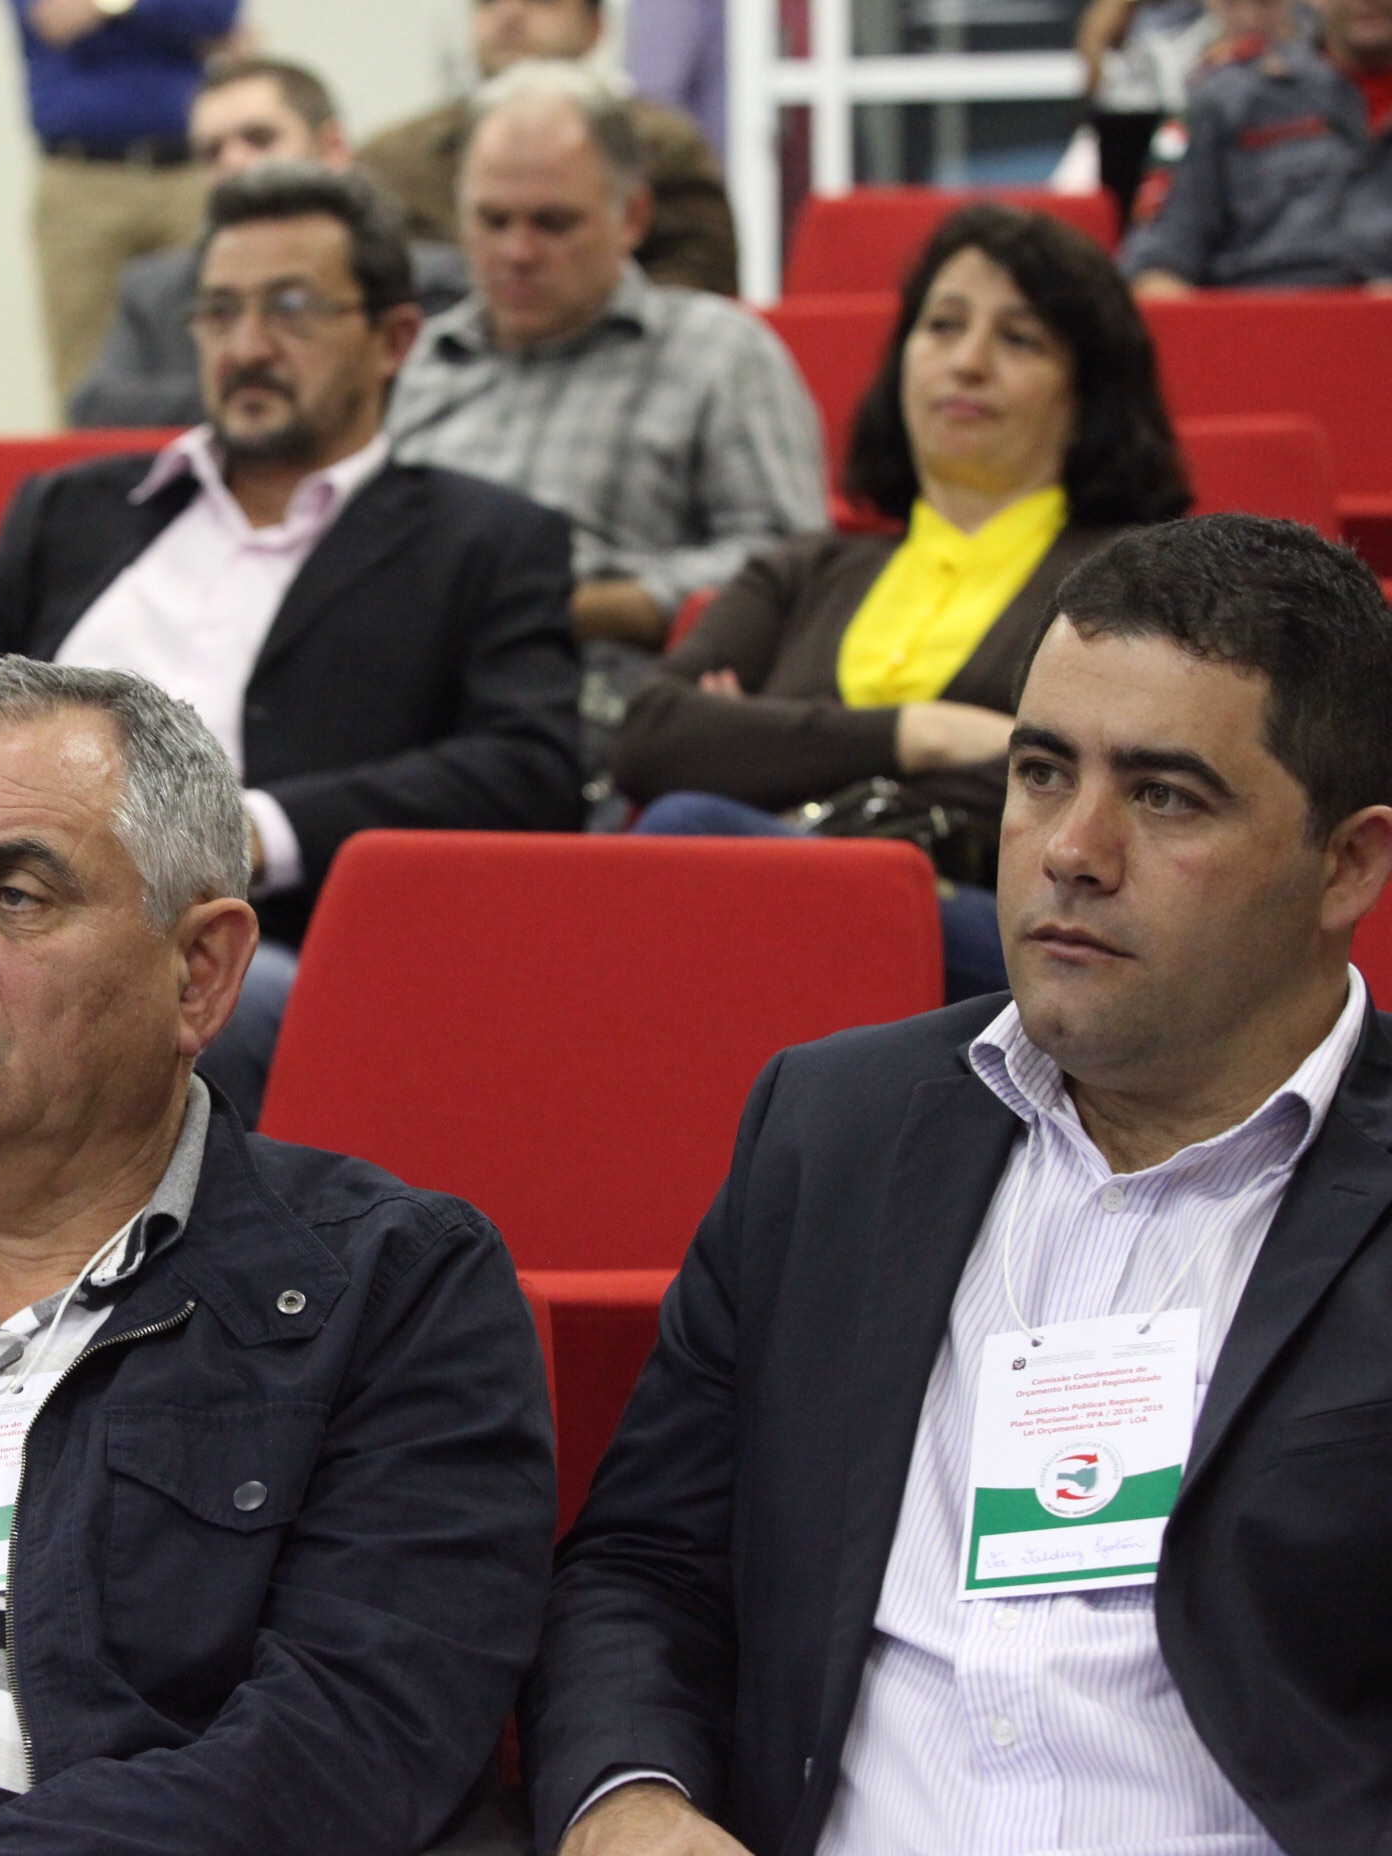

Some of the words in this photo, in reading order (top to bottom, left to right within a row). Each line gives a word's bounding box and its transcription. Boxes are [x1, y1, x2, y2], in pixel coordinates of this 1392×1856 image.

[1015, 1386, 1062, 1398] Orçamento
[1064, 1381, 1100, 1392] Estadual
[1102, 1375, 1162, 1388] Regionalizado
[1032, 1375, 1071, 1386] Comissão
[1073, 1367, 1134, 1380] Coordenadora
[1024, 1405, 1069, 1416] Audiências
[1108, 1396, 1150, 1407] Regionais
[1010, 1420, 1033, 1428] Plano
[1035, 1414, 1078, 1425] Plurianual
[1086, 1410, 1104, 1419] PPA
[1112, 1407, 1134, 1416] 2016
[1096, 1418, 1121, 1428] Anual
[1130, 1416, 1148, 1424] LOA
